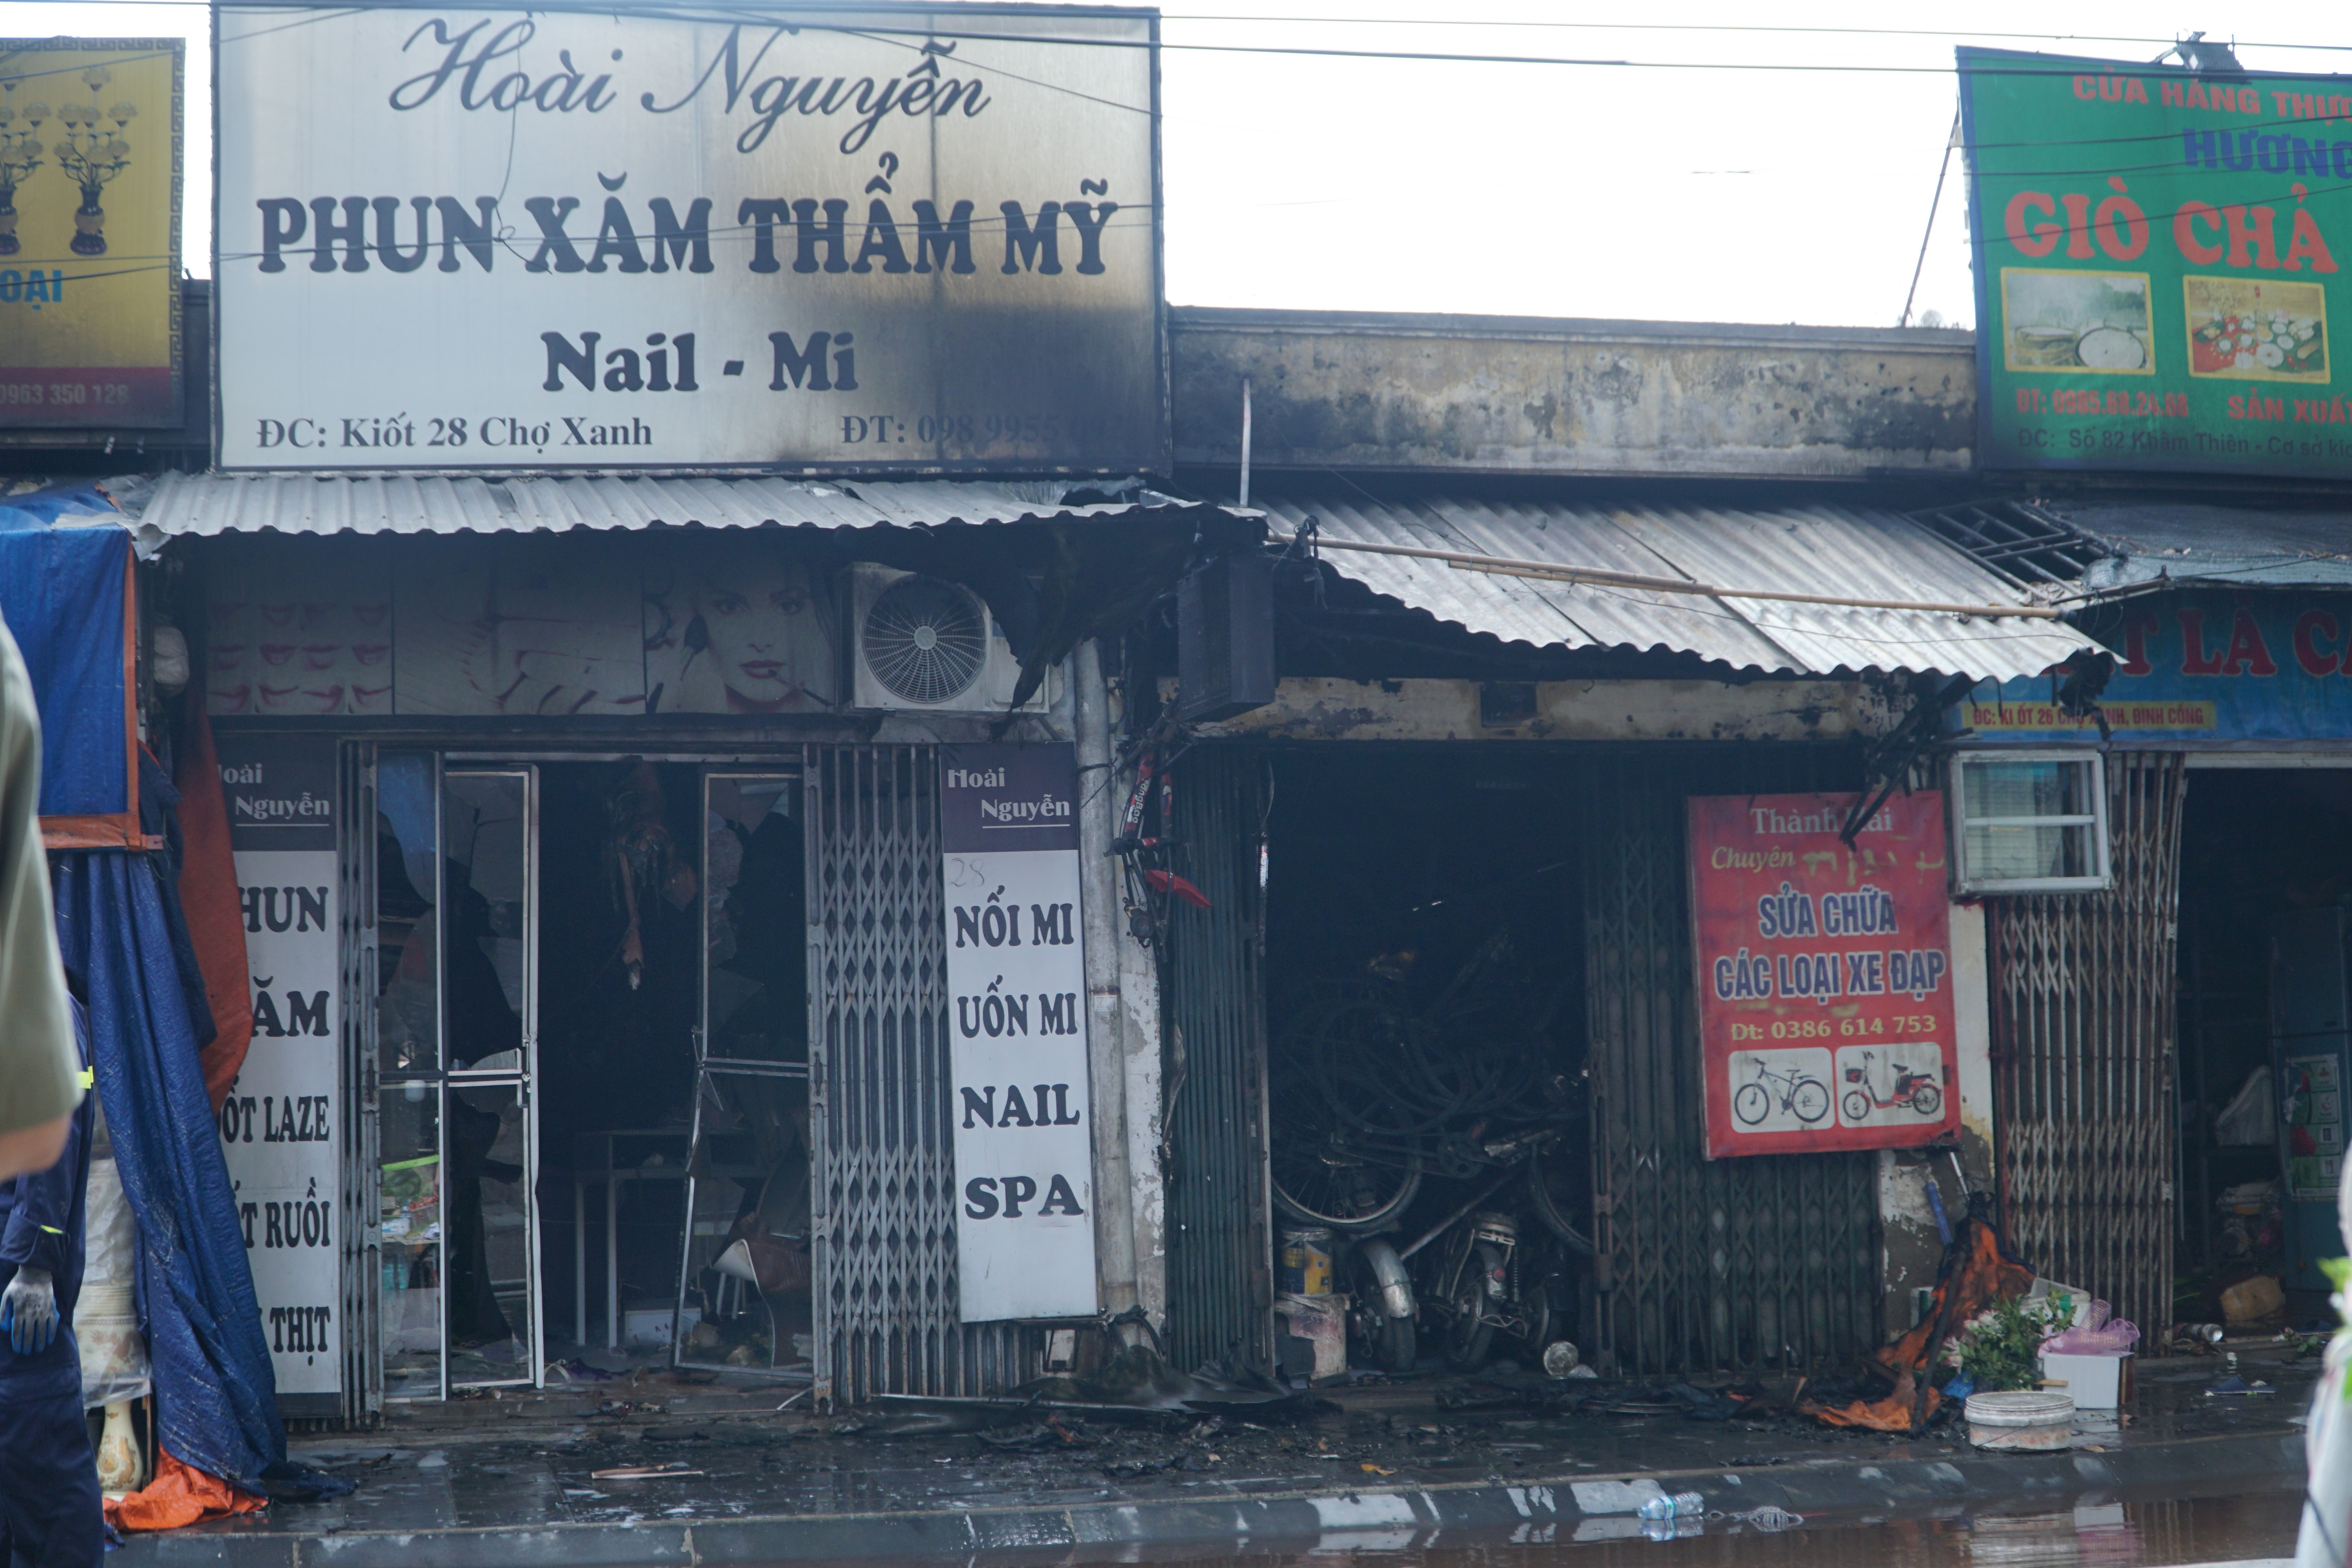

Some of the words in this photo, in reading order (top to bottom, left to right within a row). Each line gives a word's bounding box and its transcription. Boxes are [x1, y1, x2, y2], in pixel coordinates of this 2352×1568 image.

[389, 18, 622, 113] Hoài
[641, 24, 992, 154] Nguyễn
[2073, 65, 2149, 104] CỬA
[2160, 78, 2260, 114] HÀNG
[256, 196, 498, 274] PHUN
[524, 171, 714, 274] XĂM
[738, 151, 977, 275] THẨM
[999, 178, 1119, 276] MỸ
[2005, 176, 2149, 261] GIÒ
[2173, 183, 2339, 273] CHẢ
[540, 331, 700, 392] Nail
[723, 359, 744, 376] -
[768, 330, 858, 391] Mi
[50, 384, 86, 405] 350
[2016, 388, 2047, 414] ĐT:
[2053, 389, 2188, 417] 0985.68.24.68
[2228, 387, 2283, 421] SẢN
[256, 418, 326, 448] ĐC:
[339, 411, 416, 448] Kiốt
[427, 417, 468, 447] 28
[479, 417, 550, 454] Chợ
[560, 417, 653, 446] Xanh
[840, 415, 906, 444] ĐT:
[918, 415, 975, 444] 098
[2018, 428, 2055, 448] ĐC:
[2069, 426, 2096, 448] Số
[2102, 430, 2125, 449] 82
[2197, 433, 2249, 452] Thiên
[2293, 610, 2352, 676] C
[1973, 708, 1996, 725] ĐC:
[2038, 708, 2053, 725] 26
[218, 763, 262, 783] oài
[948, 767, 1005, 788] Hoài
[982, 793, 1070, 822] Nguyễn
[236, 792, 330, 820] Nguyễn
[1749, 807, 1840, 834] Thành
[1711, 845, 1796, 873] Chuyên
[954, 885, 1021, 948] NỐI
[1031, 903, 1074, 946] MI
[1759, 881, 1818, 938] SỬA
[1822, 884, 1899, 937] CHỮA
[1714, 947, 1772, 1001] CÁC
[1777, 953, 1842, 1005] LOẠI
[1846, 951, 1884, 995] XE
[1889, 949, 1946, 1002] ĐẠP
[957, 975, 1029, 1039] UỐN
[1039, 993, 1078, 1036] MI
[1731, 1023, 1764, 1040] Đt:
[1771, 1019, 1831, 1040] 0386
[1840, 1018, 1884, 1036] 614
[1892, 1014, 1936, 1034] 753
[264, 1095, 330, 1142] LAZE
[960, 1083, 1080, 1129] NAIL
[265, 1177, 331, 1248] RUỒI
[965, 1174, 1084, 1220] SPA
[270, 1306, 330, 1367] THỊT
